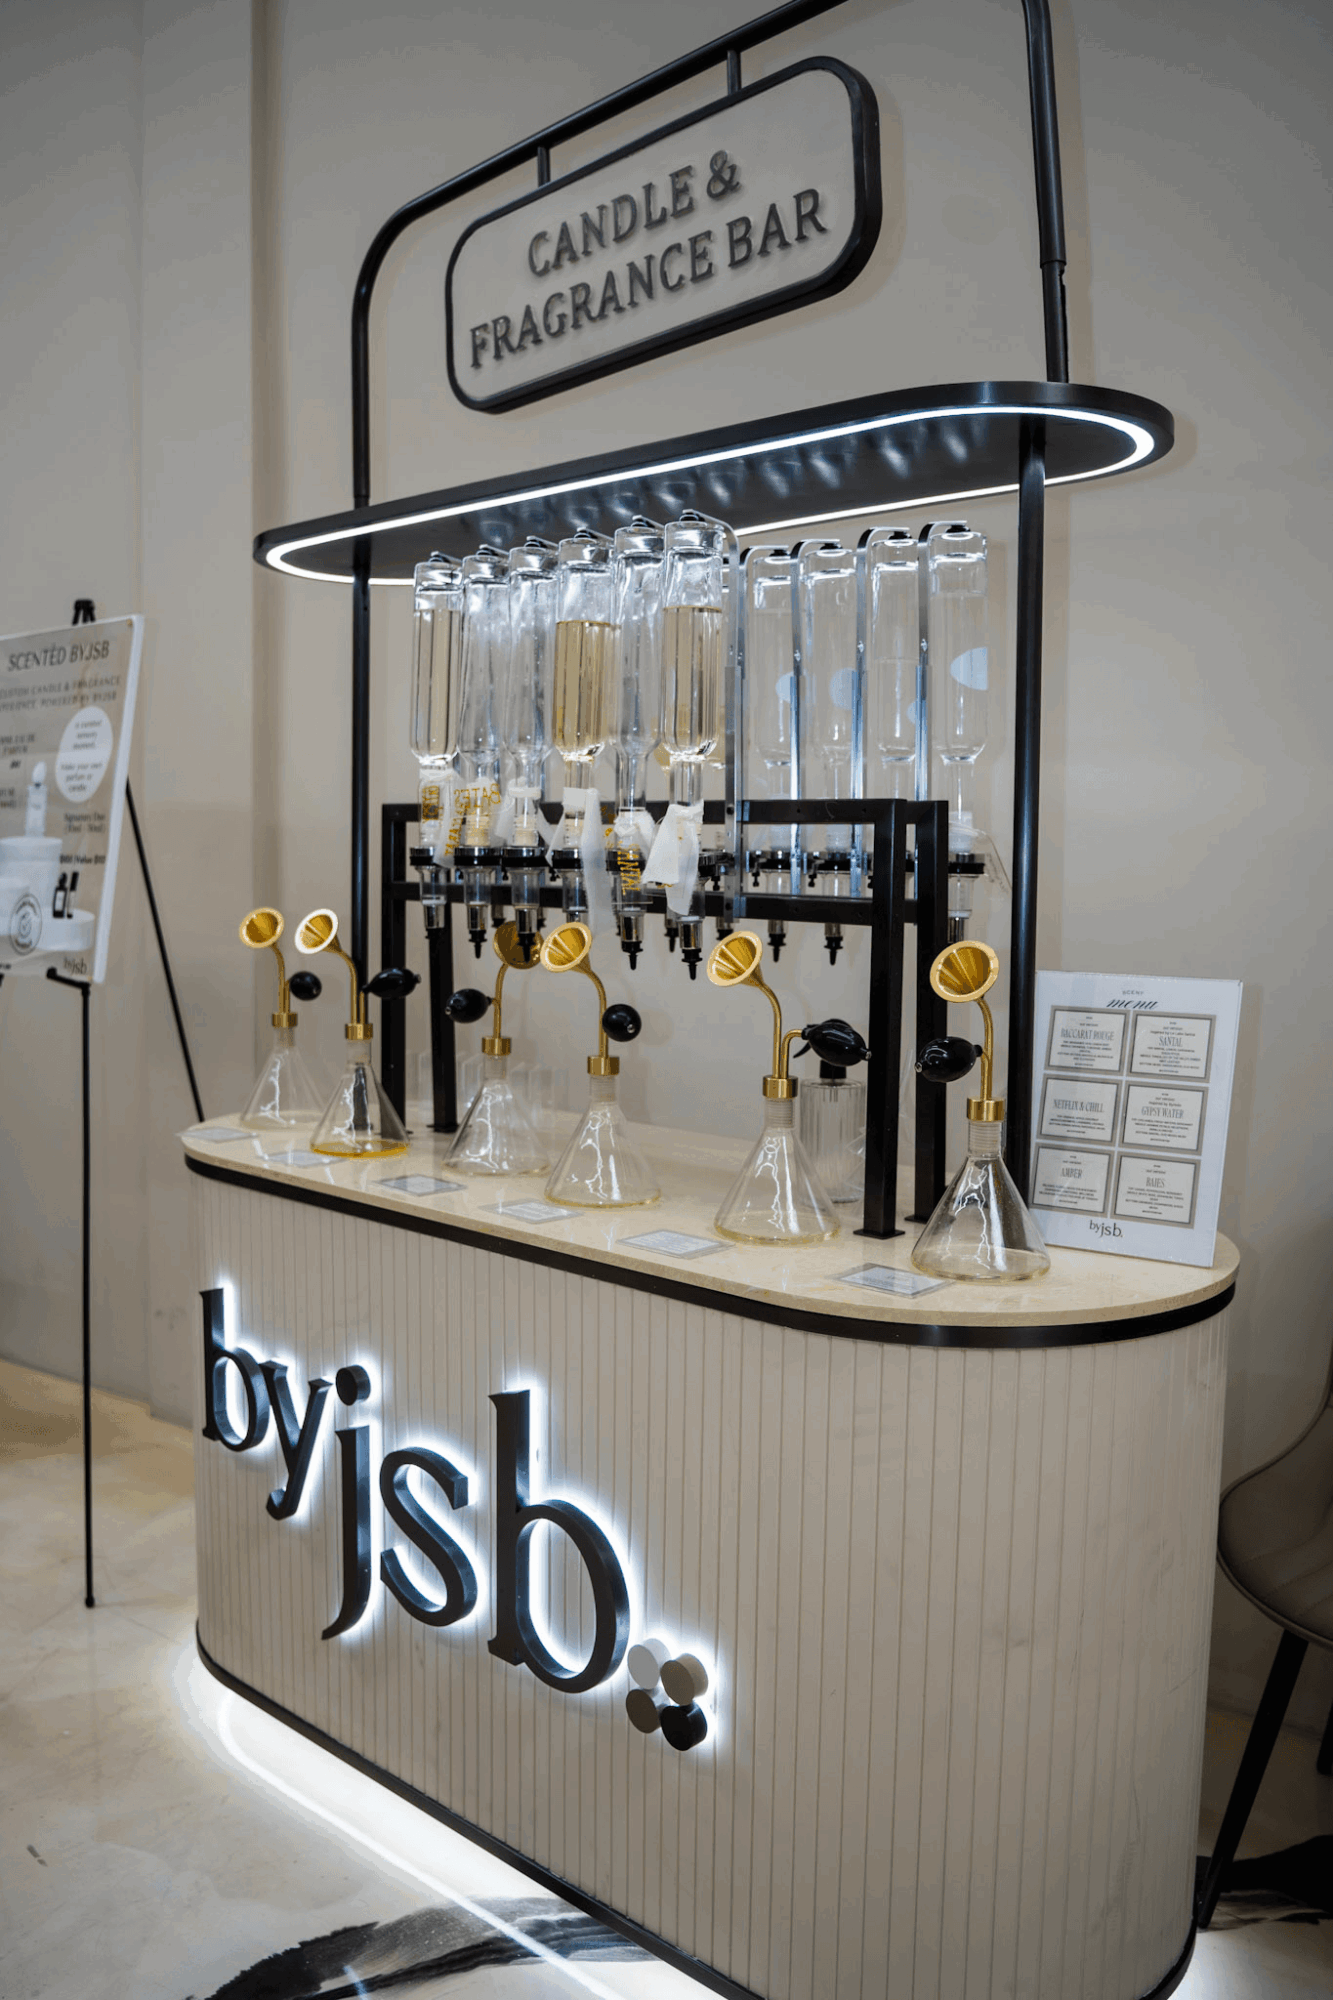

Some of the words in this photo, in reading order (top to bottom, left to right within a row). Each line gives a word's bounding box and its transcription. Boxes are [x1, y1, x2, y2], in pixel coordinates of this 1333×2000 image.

[527, 164, 696, 278] CANDLE
[705, 149, 743, 201] &
[469, 229, 715, 370] FRAGRANCE
[726, 187, 829, 269] BAR
[1158, 1036, 1183, 1047] SANTAL
[1053, 1098, 1079, 1111] NETFLIX
[1085, 1101, 1105, 1113] CHILL
[1141, 1105, 1162, 1117] GYPSY
[1162, 1107, 1185, 1119] WATER
